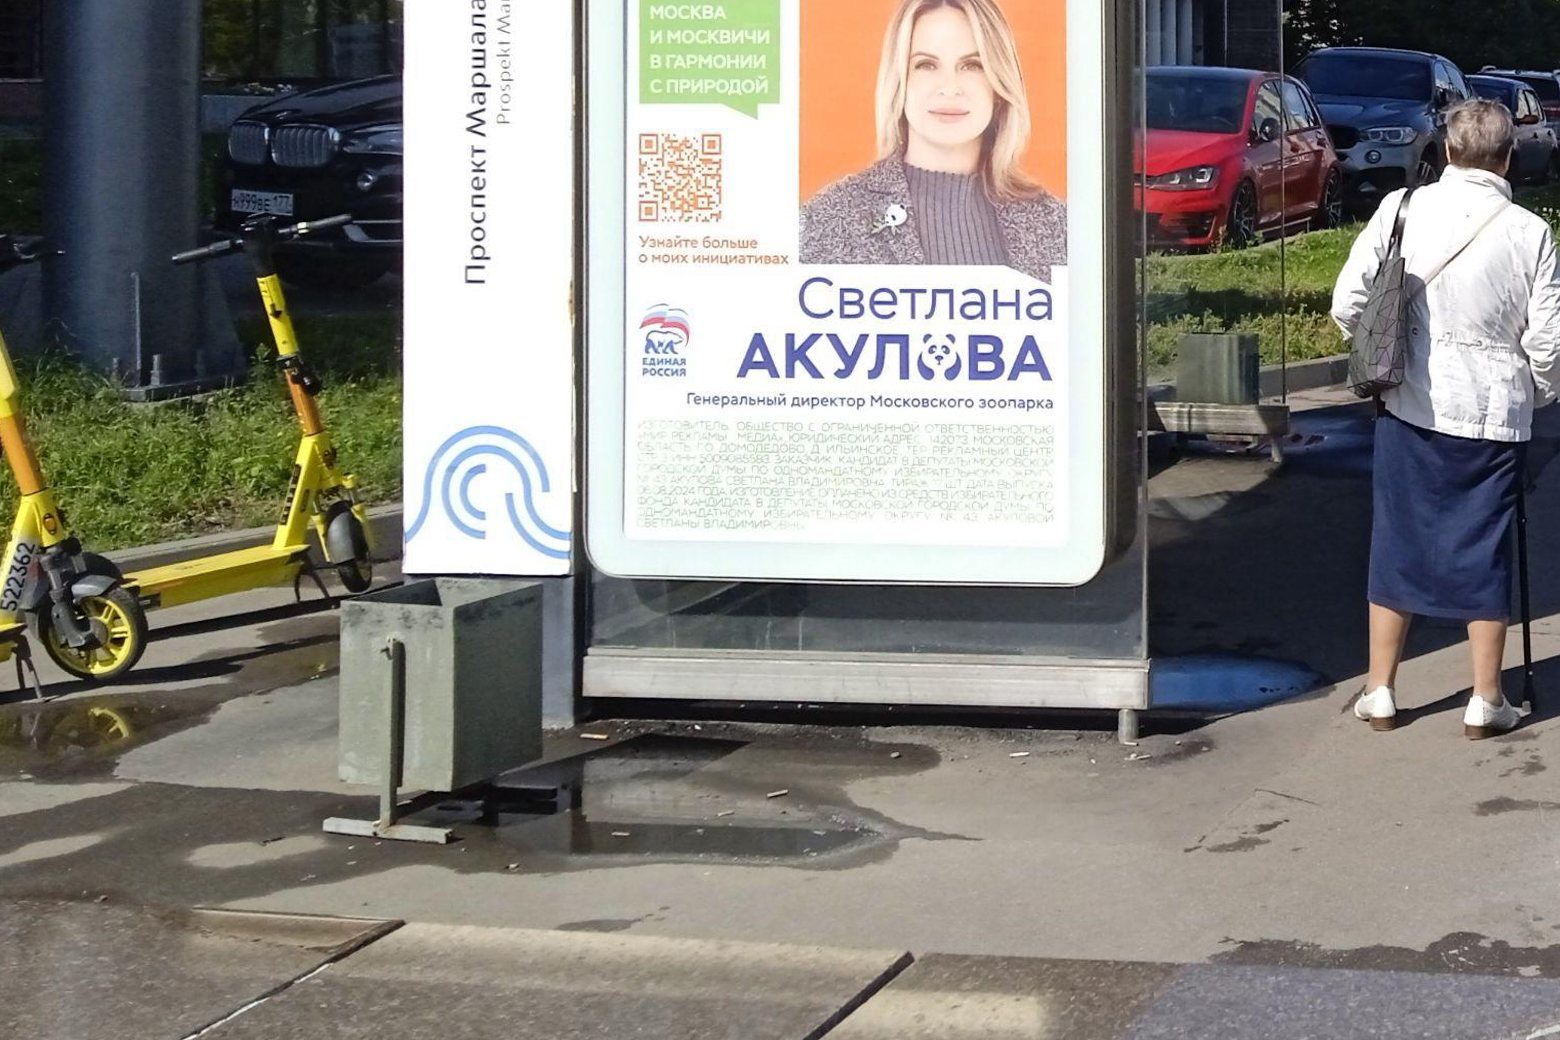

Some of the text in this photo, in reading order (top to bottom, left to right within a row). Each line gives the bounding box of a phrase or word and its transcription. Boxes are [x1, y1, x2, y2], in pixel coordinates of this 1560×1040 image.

[650, 5, 727, 20] МОСКВА
[650, 29, 770, 45] И МОСКВИЧИ
[650, 54, 767, 69] В ГАРМОНИИ
[495, 40, 514, 124] Prospekt
[650, 75, 769, 96] С ПРИРОДОЙ
[464, 145, 489, 285] Проспект
[638, 235, 759, 249] Узнайте больше
[638, 254, 789, 266] о моих инициативах
[798, 276, 1053, 321] Светлана
[642, 357, 687, 366] ЕДИНАЯ
[642, 367, 687, 377] РОССИЯ
[686, 392, 1054, 411] Генеральный директор Московского зоопарка
[1, 542, 36, 612] 522362
